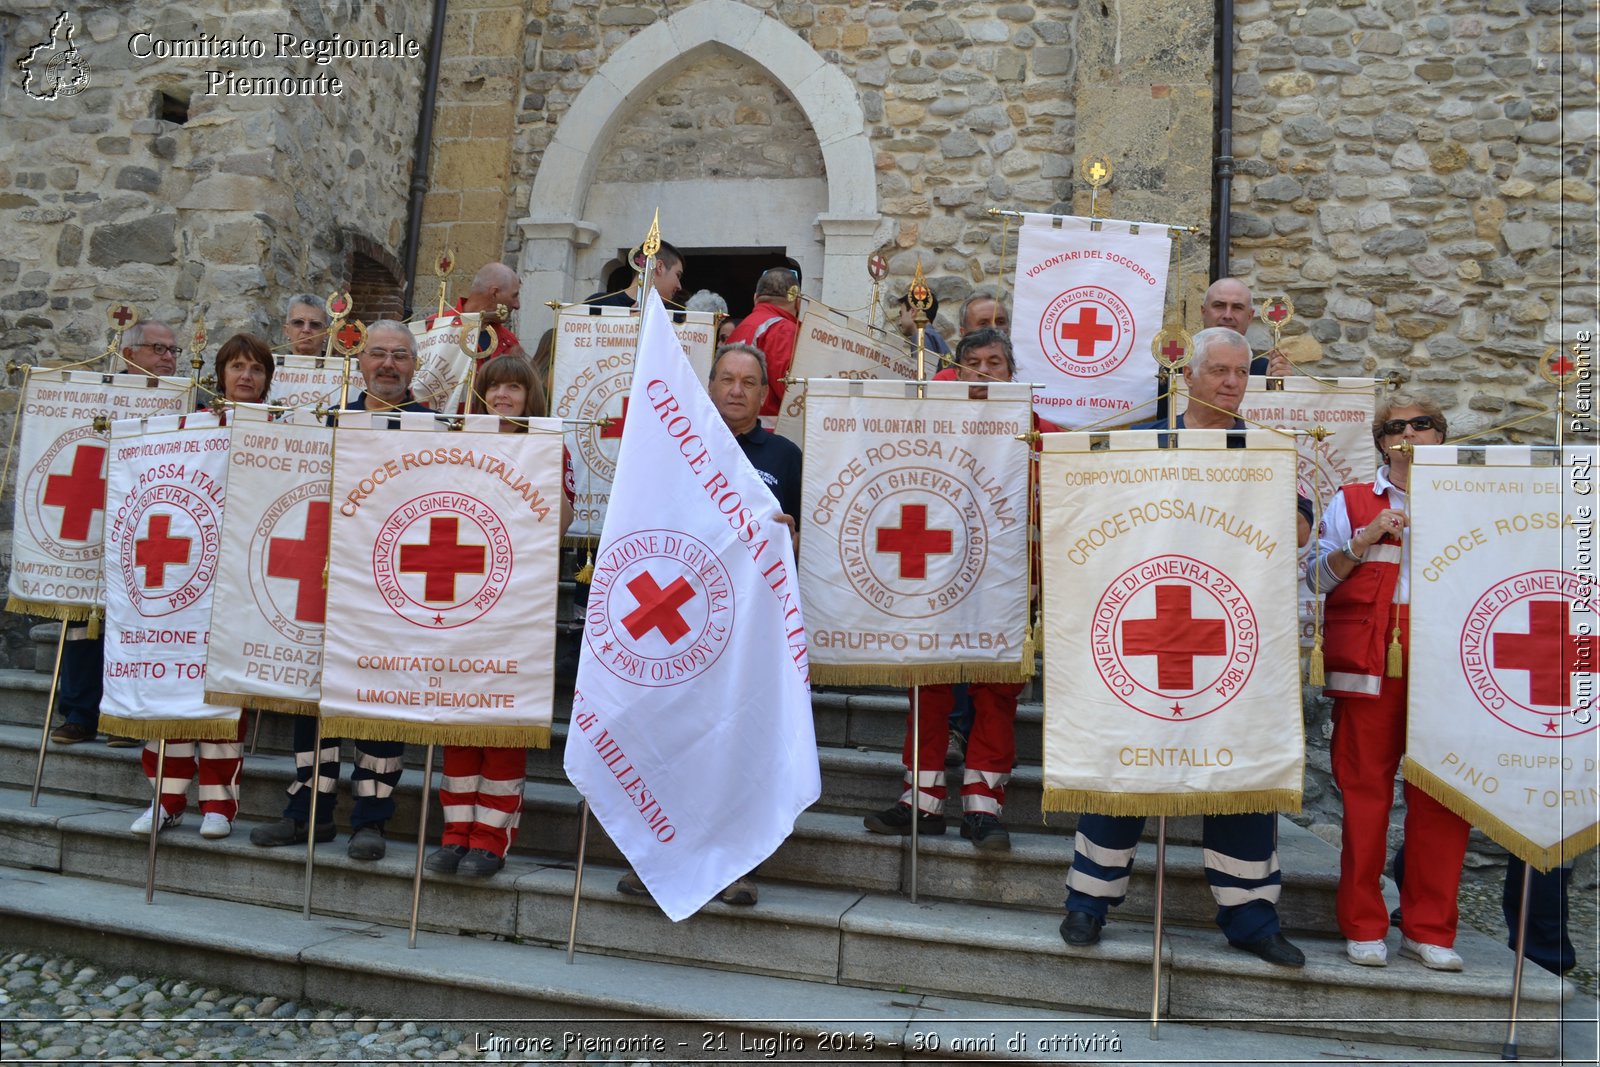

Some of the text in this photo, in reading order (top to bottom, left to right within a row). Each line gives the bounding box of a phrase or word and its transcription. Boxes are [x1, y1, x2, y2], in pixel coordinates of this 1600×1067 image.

[1026, 250, 1156, 286] VOLONTARI DEL SOCCORSO
[1045, 290, 1131, 334] CONVENZIONE DI GINEVRA
[811, 328, 839, 347] CORPO
[841, 338, 880, 363] VOLONTARI
[1052, 352, 1119, 374] 22 AGOSTO 1864
[311, 373, 327, 385] DEL
[556, 351, 635, 418] CROCE ROS
[63, 389, 109, 405] VOLONTARI
[113, 395, 131, 408] DEL
[134, 397, 183, 410] SOCCORSO
[597, 385, 610, 400] DI
[1032, 394, 1073, 407] Gruppo
[1076, 396, 1086, 407] di
[26, 403, 68, 419] CROCE
[1291, 408, 1309, 422] DEL
[1313, 409, 1366, 423] SOCCORSO
[823, 416, 1019, 436] CORPO VOLONTARI DEL SOCCORSO
[184, 440, 201, 453] DEL
[204, 438, 230, 452] SOCC
[243, 434, 330, 456] CORPO VOLONTA
[232, 451, 331, 475] CROCE ROS
[646, 379, 712, 475] CROCE
[702, 470, 770, 563] ROSSA
[340, 447, 551, 523] CROCE ROSSA ITALIANA
[813, 439, 1017, 530] CROCE ROSSA ITALIANA
[1065, 467, 1273, 486] CORPO VOLONTARI DEL SOCCORSO
[1432, 479, 1523, 493] VOLONTARI
[1533, 482, 1563, 494] DEL
[111, 485, 138, 543] CROCE
[139, 463, 186, 490] ROSSA
[141, 488, 191, 507] GINEVRA
[191, 502, 209, 521] 22
[844, 471, 984, 610] CONVENZIONE DI GINEVRA 22 AGOSTO 1864
[1067, 499, 1278, 566] CROCE ROSSA ITALIANA
[198, 523, 218, 582] AGOSTO
[377, 496, 509, 611] CONVENZIONE DI GINEVRA 22 AGOSTO 1864
[1422, 527, 1487, 582] CROCE
[1494, 512, 1579, 536] ROSSA
[169, 583, 200, 609] 1864
[588, 535, 729, 681] CONVENZIONE DI GINEVRA 22 AGOSTO 1864
[813, 629, 1009, 651] GRUPPO DI ALBA
[1095, 560, 1254, 698] CONVENZIONE DI GINEVRA 22 AGOSTO 1864
[242, 642, 321, 666] DELEGAZI
[1464, 598, 1506, 711] CONVENZIONE
[1494, 589, 1513, 603] DI
[356, 655, 518, 674] COMITATO LOCALE
[428, 676, 442, 688] DI
[356, 688, 515, 709] LIMONE PIEMONTE
[1119, 747, 1233, 767] CENTALLO
[1497, 753, 1573, 771] GRUPPO
[575, 711, 676, 843] di MILLESIMO
[1440, 751, 1499, 795] PINO
